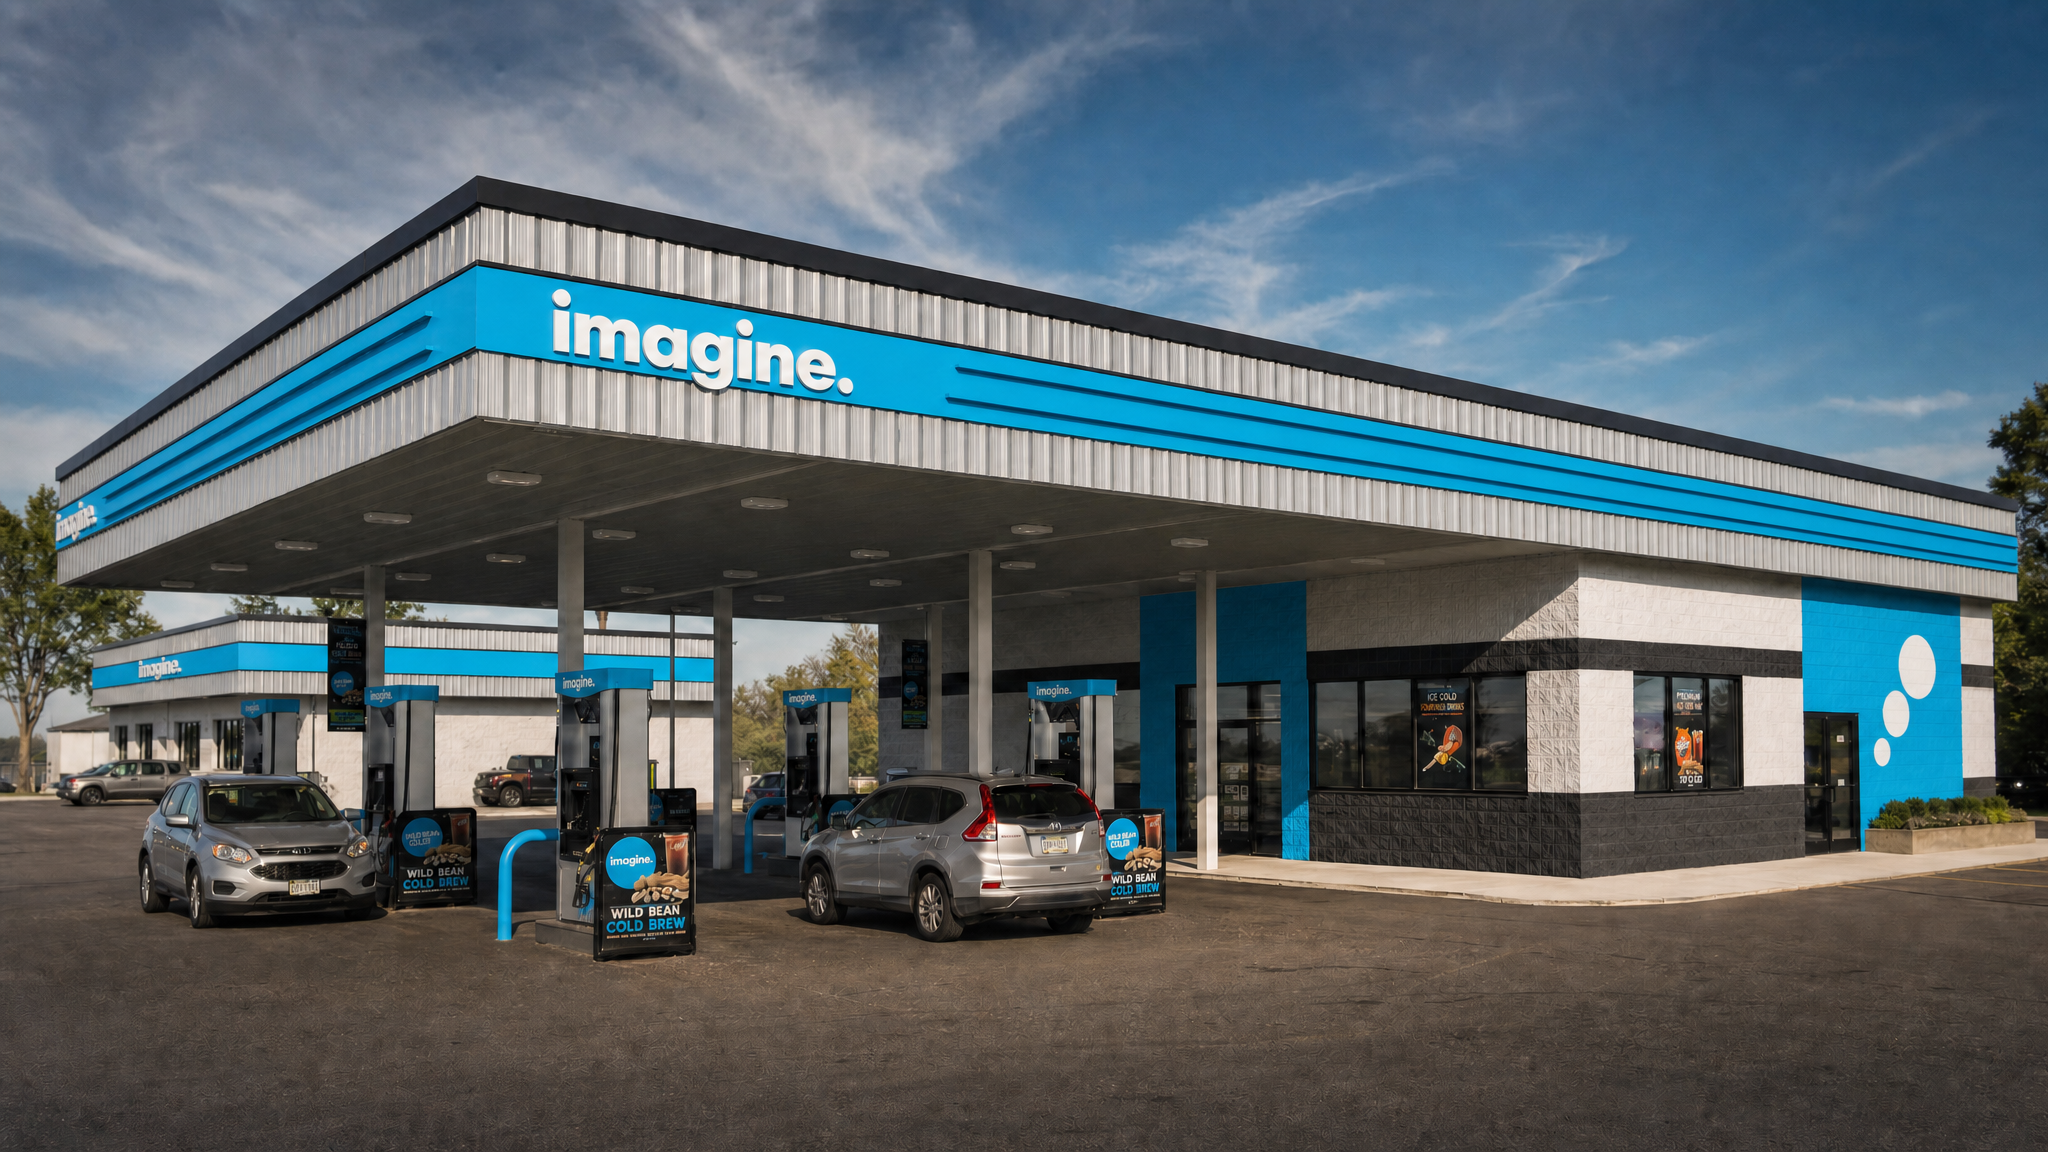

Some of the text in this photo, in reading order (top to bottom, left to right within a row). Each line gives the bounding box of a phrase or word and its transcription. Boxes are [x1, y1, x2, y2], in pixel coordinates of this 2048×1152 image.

[552, 289, 854, 395] imagine.
[1427, 692, 1457, 701] ICE COLD
[407, 866, 465, 878] WILD BEAN
[1111, 872, 1157, 884] WILD BEAN
[403, 878, 434, 890] COLD
[1110, 885, 1134, 896] COLD
[610, 904, 680, 919] WILD BEAN
[606, 916, 686, 934] COLD BREW
